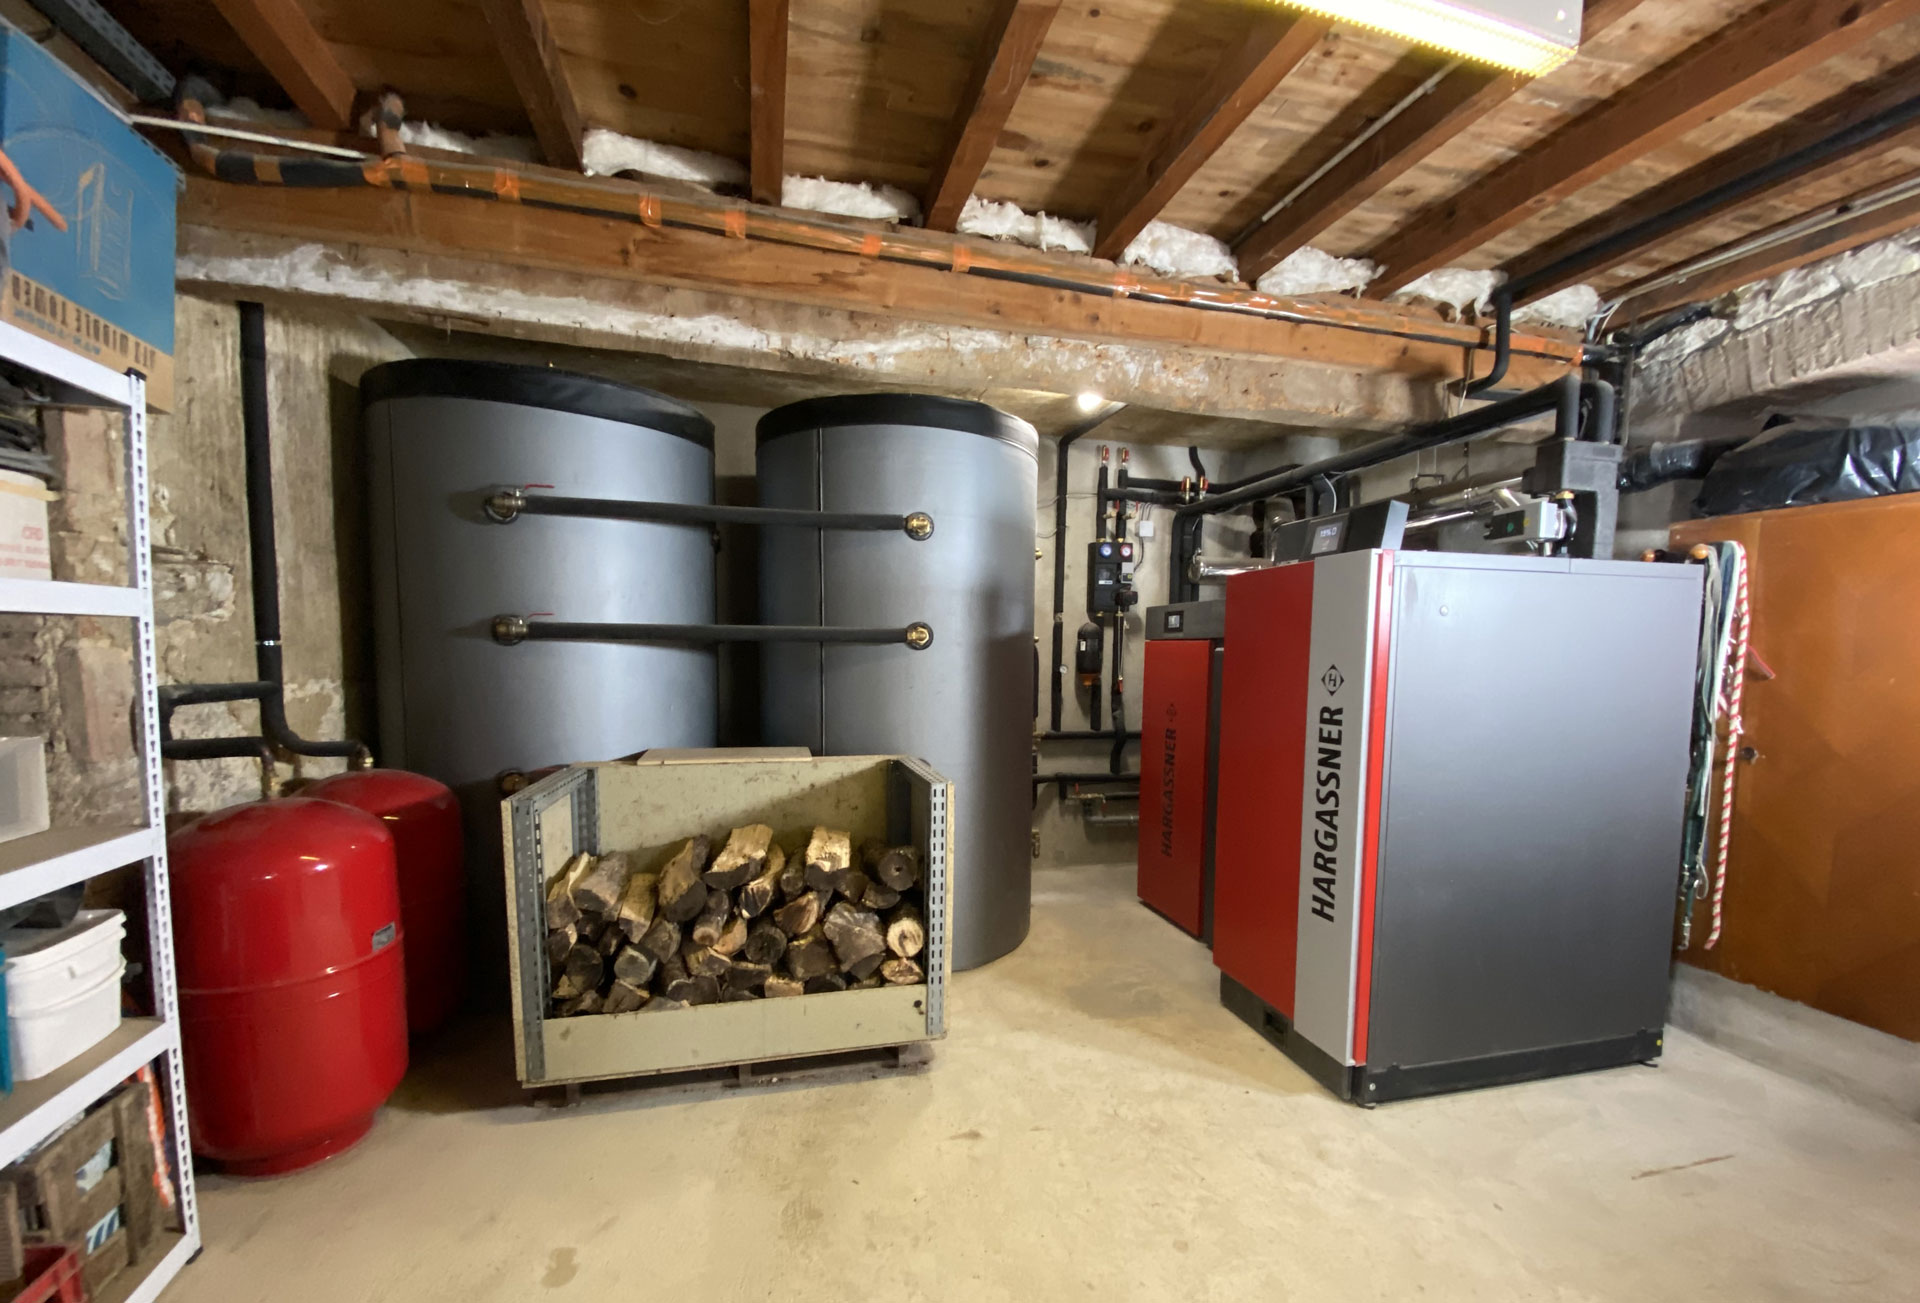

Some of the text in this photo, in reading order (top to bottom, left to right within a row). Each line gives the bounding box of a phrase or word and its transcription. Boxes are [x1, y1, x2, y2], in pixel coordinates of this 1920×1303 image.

[12, 273, 67, 327] TOWER
[75, 307, 129, 356] MIDDLE
[1161, 727, 1177, 858] HARGASSNER
[1311, 705, 1344, 923] HARGASSNER
